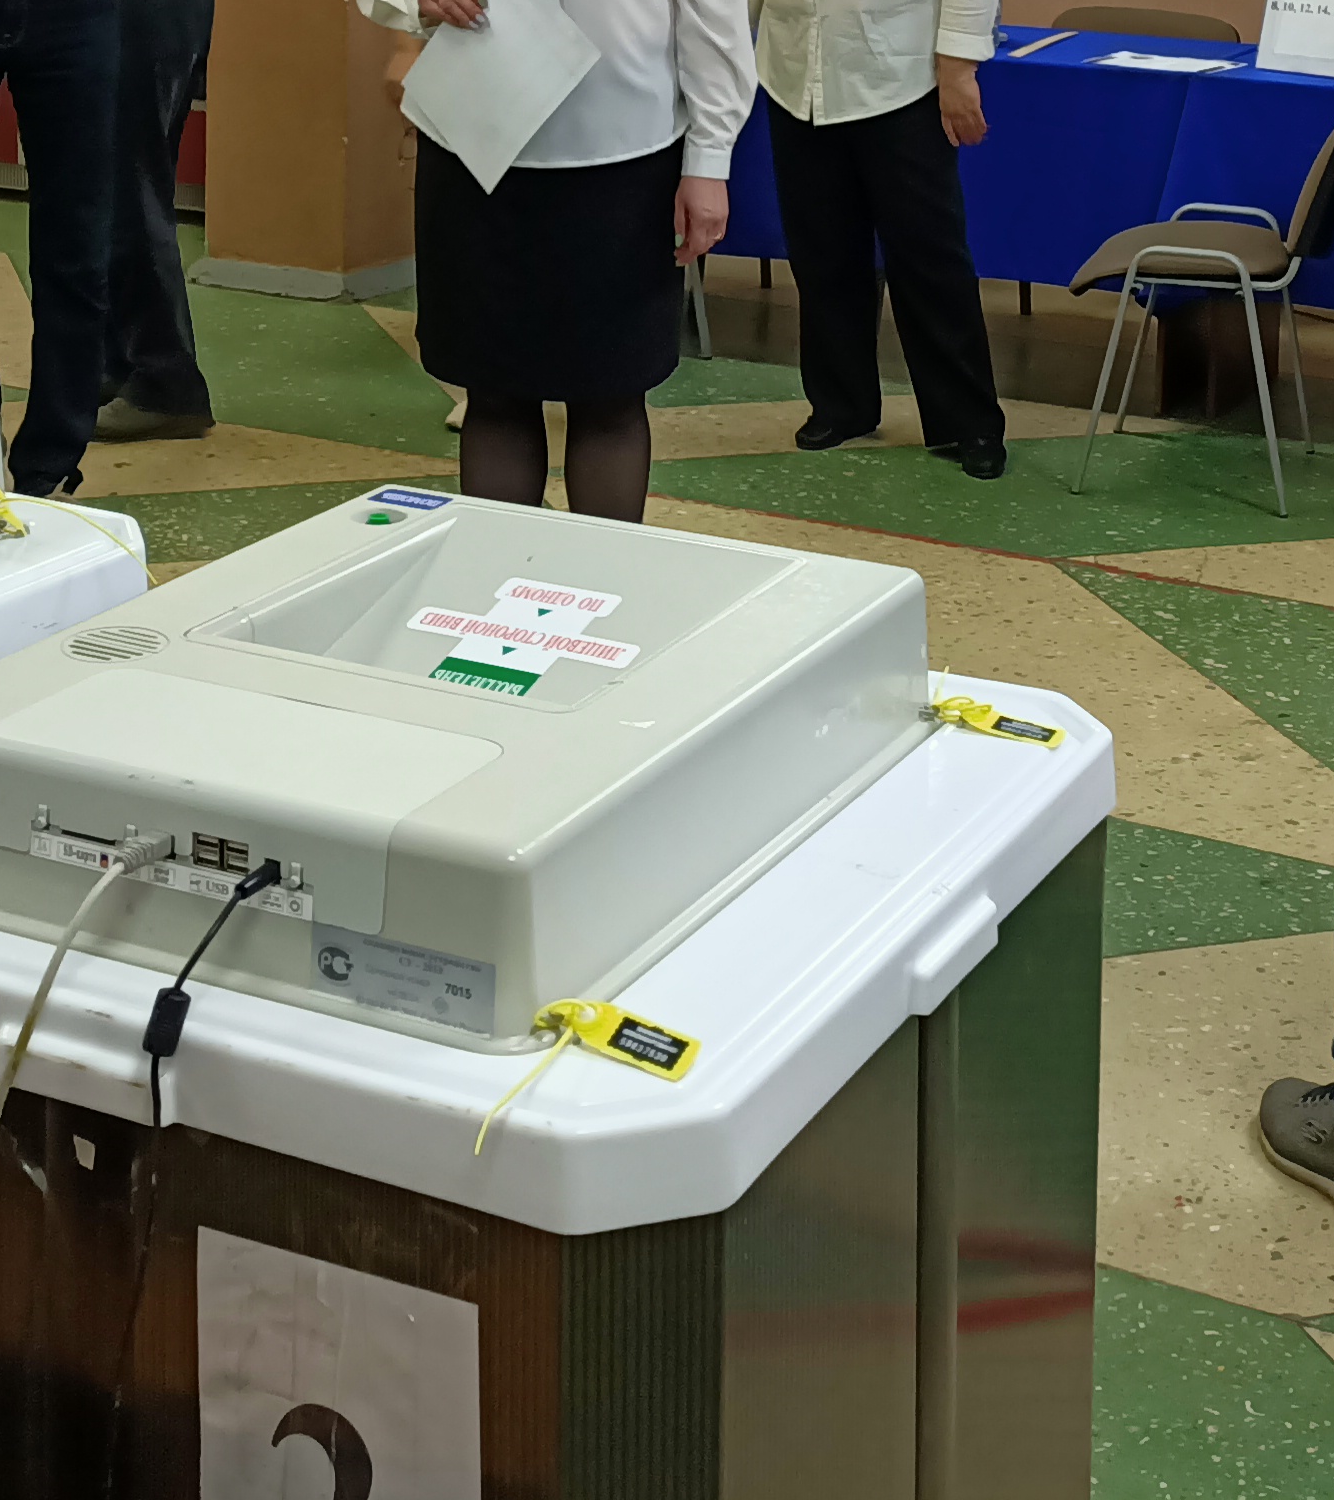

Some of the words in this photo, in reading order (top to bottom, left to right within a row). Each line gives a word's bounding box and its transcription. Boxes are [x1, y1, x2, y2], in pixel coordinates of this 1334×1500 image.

[507, 584, 576, 607] ОДНОМУ
[577, 596, 606, 613] ПО
[419, 611, 465, 631] ВНИЗ
[459, 617, 547, 645] СТОРОНОЙ
[542, 633, 627, 662] ЛИЦЕВОЙ
[205, 874, 230, 896] USB
